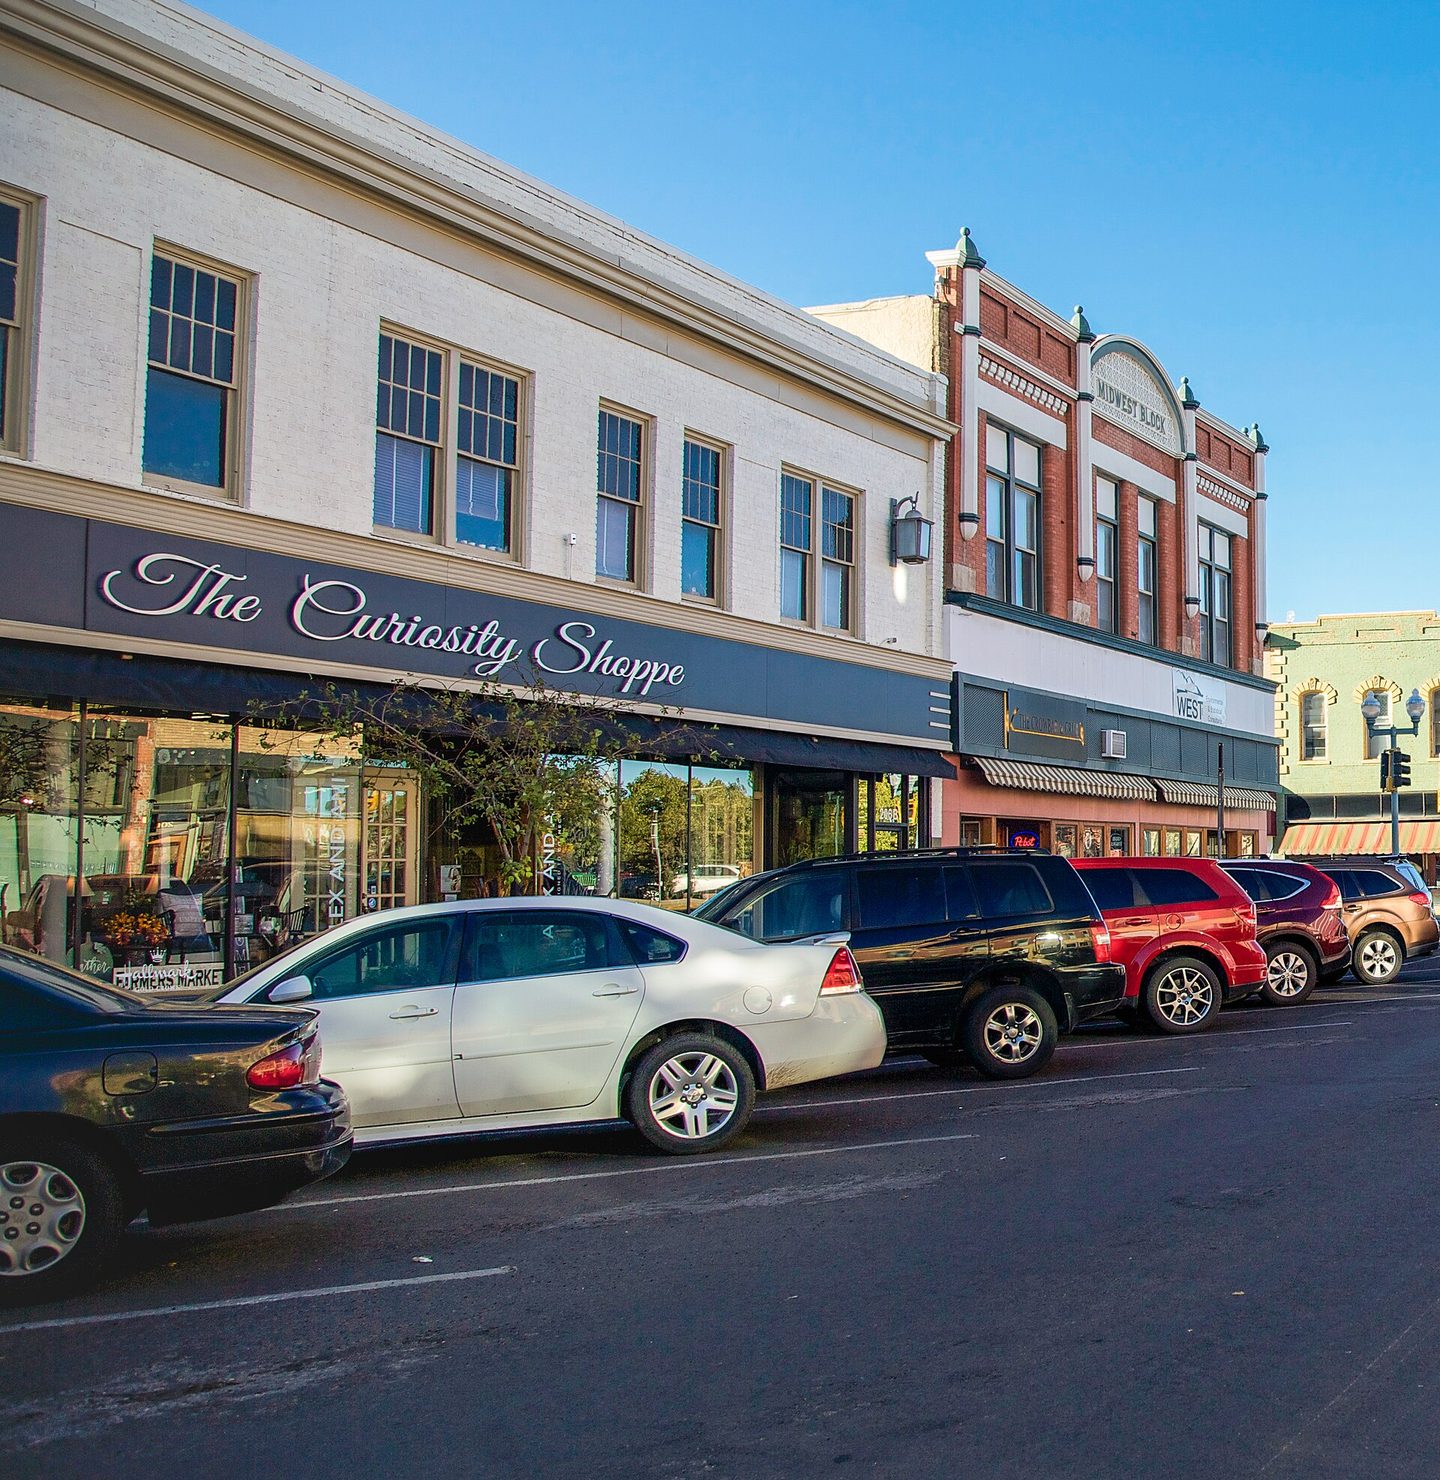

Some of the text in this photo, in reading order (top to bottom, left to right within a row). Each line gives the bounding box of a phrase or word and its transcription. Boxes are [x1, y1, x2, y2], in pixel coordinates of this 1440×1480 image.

[1096, 378, 1166, 435] MIDWEST BLOCK
[103, 553, 686, 697] The Curiosity Shoppe
[1177, 696, 1203, 720] WEST
[329, 827, 346, 882] AND
[543, 831, 555, 881] AND
[115, 959, 200, 990] Hallmark
